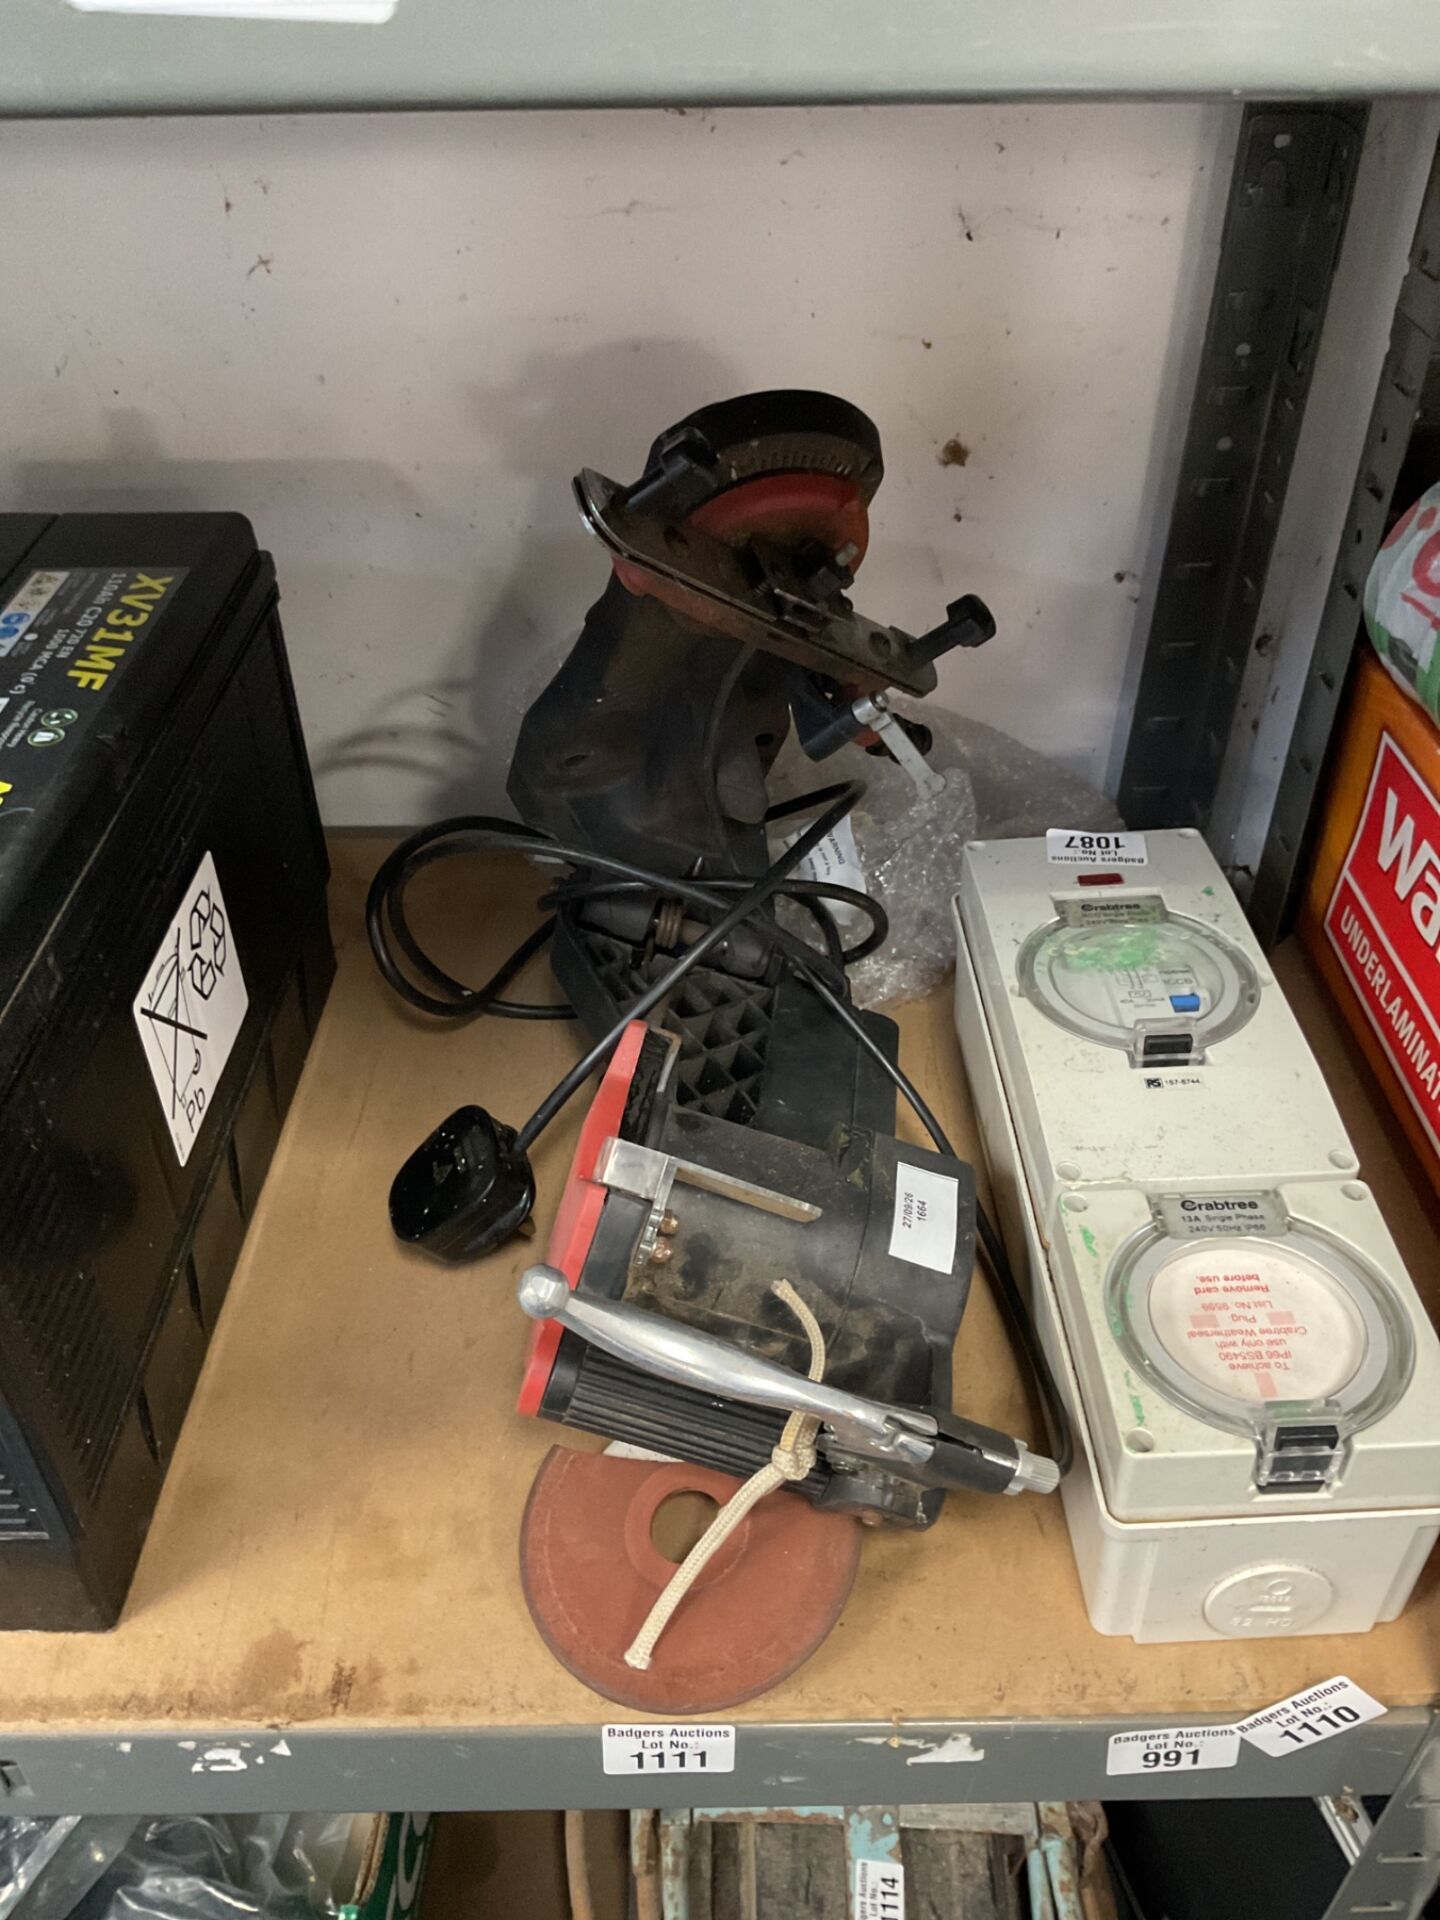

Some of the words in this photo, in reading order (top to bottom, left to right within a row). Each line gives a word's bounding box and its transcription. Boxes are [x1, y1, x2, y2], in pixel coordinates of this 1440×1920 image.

[66, 572, 174, 691] XV31MF
[1064, 836, 1126, 849] 1087
[1051, 855, 1097, 863] Auctions
[1101, 856, 1145, 864] Badgers
[1377, 786, 1440, 966] Wa
[1080, 903, 1141, 912] Crabtree
[1340, 904, 1440, 1112] UNDERLAMINAT
[916, 1199, 928, 1222] 1664
[1180, 1199, 1259, 1212] Crabtree
[1235, 1213, 1265, 1221] Phase
[1223, 1273, 1260, 1282] before
[1193, 1285, 1219, 1295] card
[1222, 1283, 1270, 1293] Remove
[1253, 1299, 1274, 1308] List
[1230, 1313, 1257, 1323] Plug
[1186, 1328, 1257, 1339] Weatherseal
[1258, 1326, 1308, 1335] Crabtree
[1215, 1340, 1239, 1348] with
[1241, 1338, 1264, 1347] only
[1265, 1338, 1287, 1346] use
[1228, 1361, 1272, 1370] achieve
[1274, 1361, 1290, 1370] To
[1236, 1705, 1291, 1734] Badgers
[1290, 1680, 1349, 1710] Auctions
[1275, 1715, 1300, 1729] Lot
[1279, 1705, 1361, 1744] 1110
[607, 1727, 665, 1739] Badgers
[669, 1727, 731, 1738] Auctions
[1113, 1732, 1171, 1745] Badgers
[1174, 1727, 1237, 1740] Auctions
[641, 1740, 664, 1749] Lot
[1145, 1740, 1171, 1751] Lot
[629, 1751, 707, 1769] 1111
[1141, 1749, 1200, 1769] 991
[858, 1861, 868, 1899] Auctions
[869, 1902, 879, 1917] Lot
